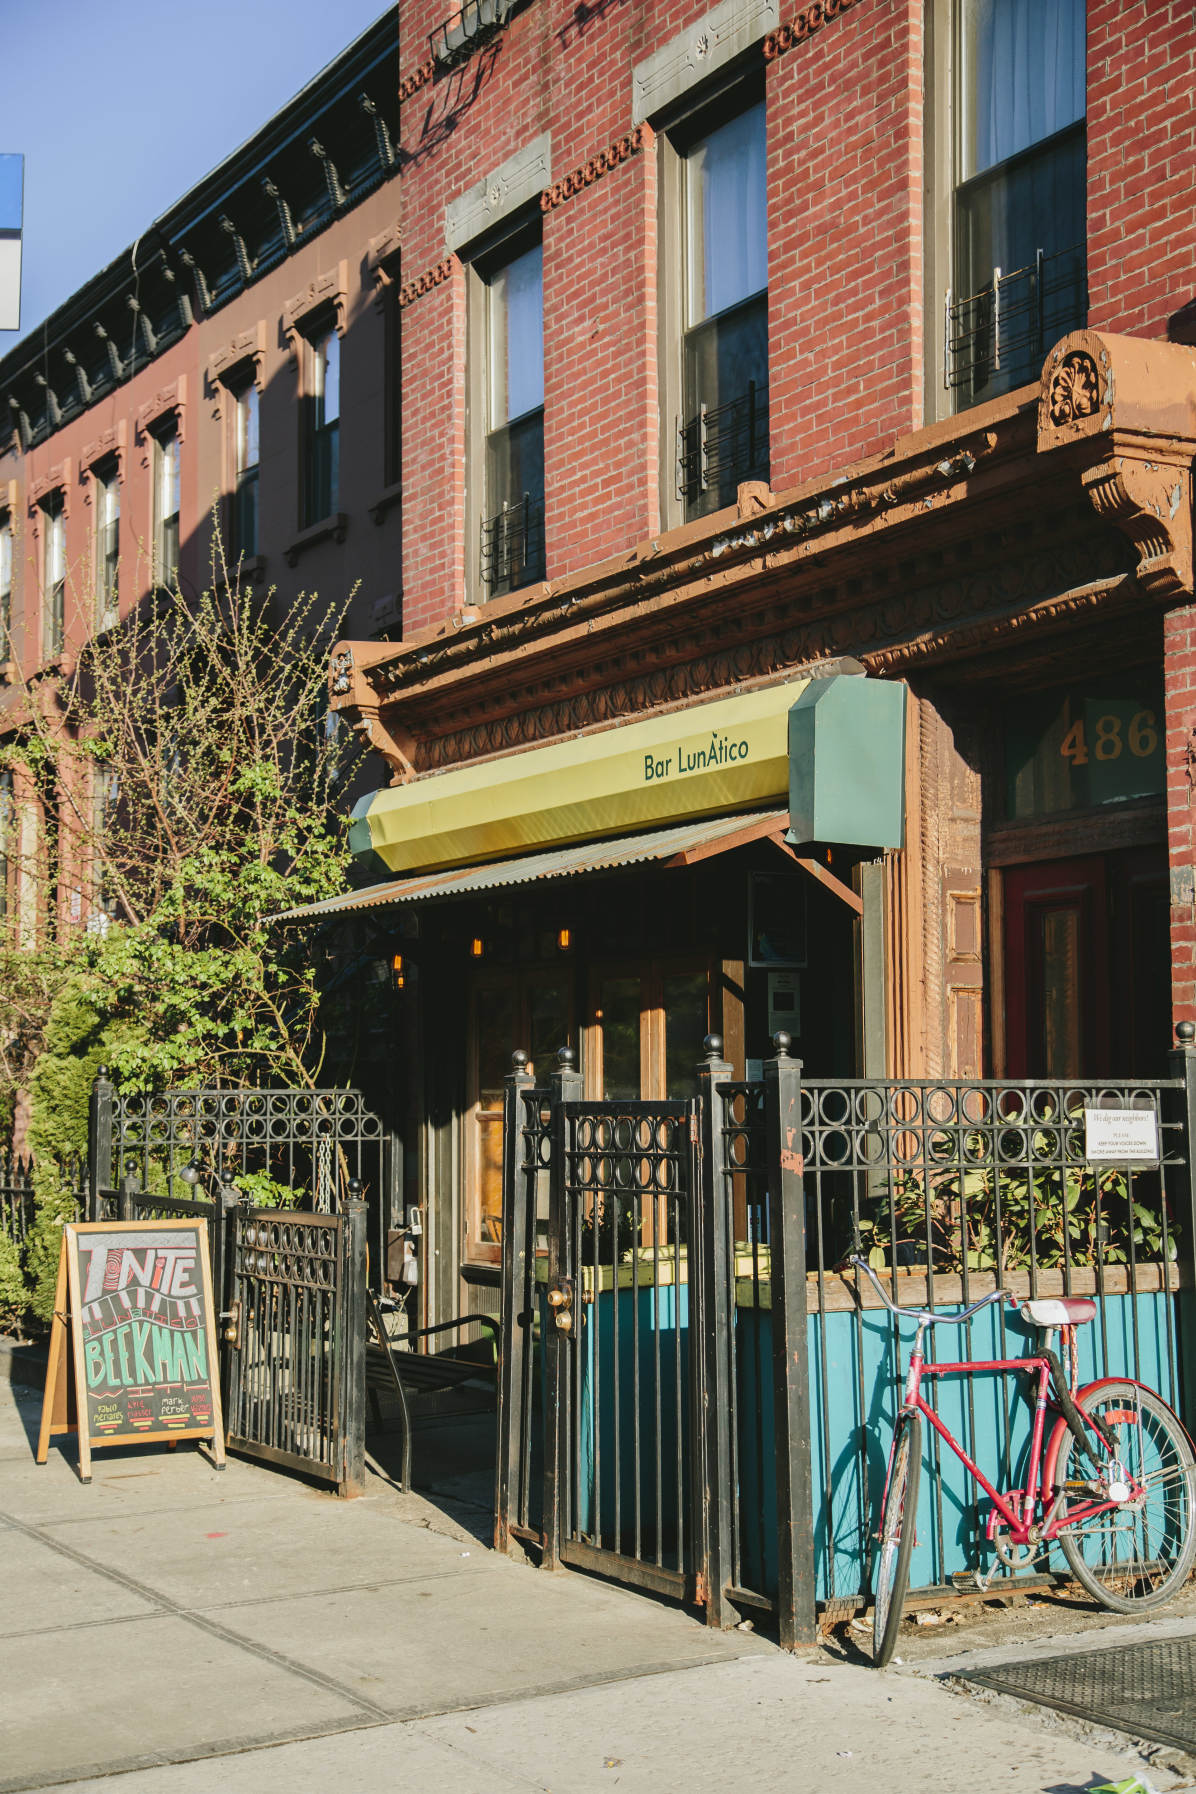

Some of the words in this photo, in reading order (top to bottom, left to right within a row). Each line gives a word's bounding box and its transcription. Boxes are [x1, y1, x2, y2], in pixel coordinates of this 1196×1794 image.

[1060, 710, 1158, 765] 486
[644, 755, 672, 781] Bar
[85, 1322, 209, 1388] BEEKMAN
